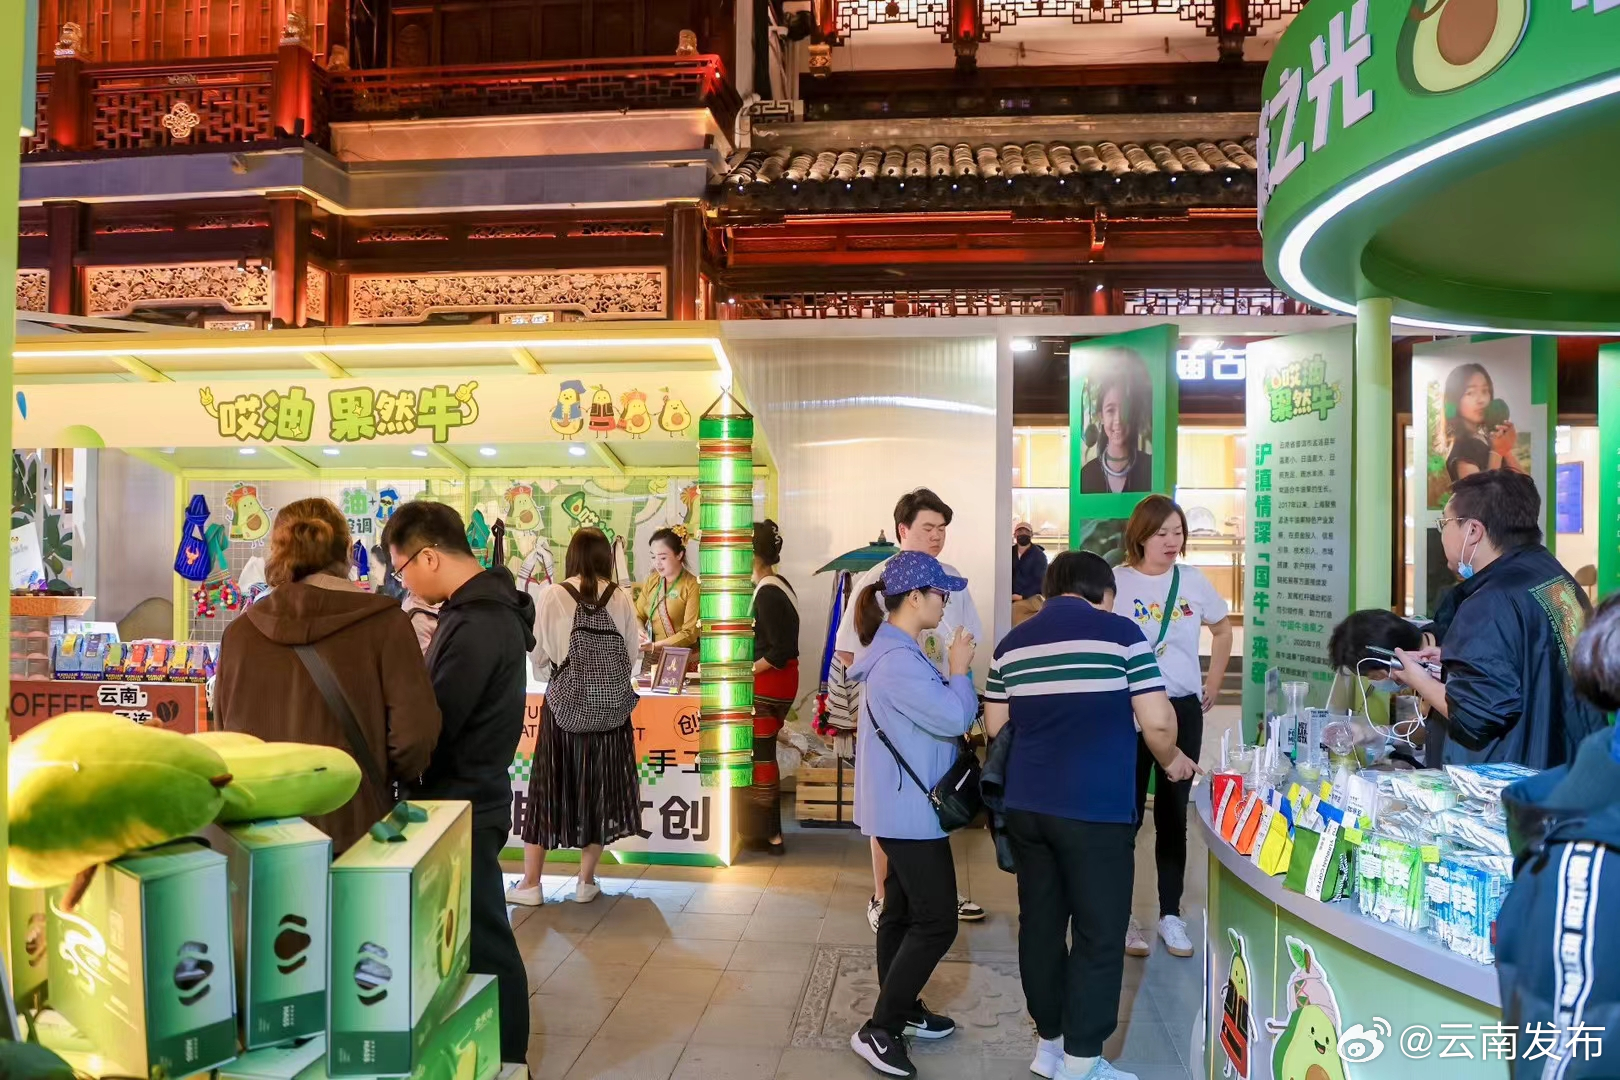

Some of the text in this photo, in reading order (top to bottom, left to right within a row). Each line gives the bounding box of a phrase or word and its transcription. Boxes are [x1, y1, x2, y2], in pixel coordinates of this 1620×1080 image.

[217, 385, 464, 443] 哎油 果然牛
[1270, 384, 1336, 422] 果然牛
